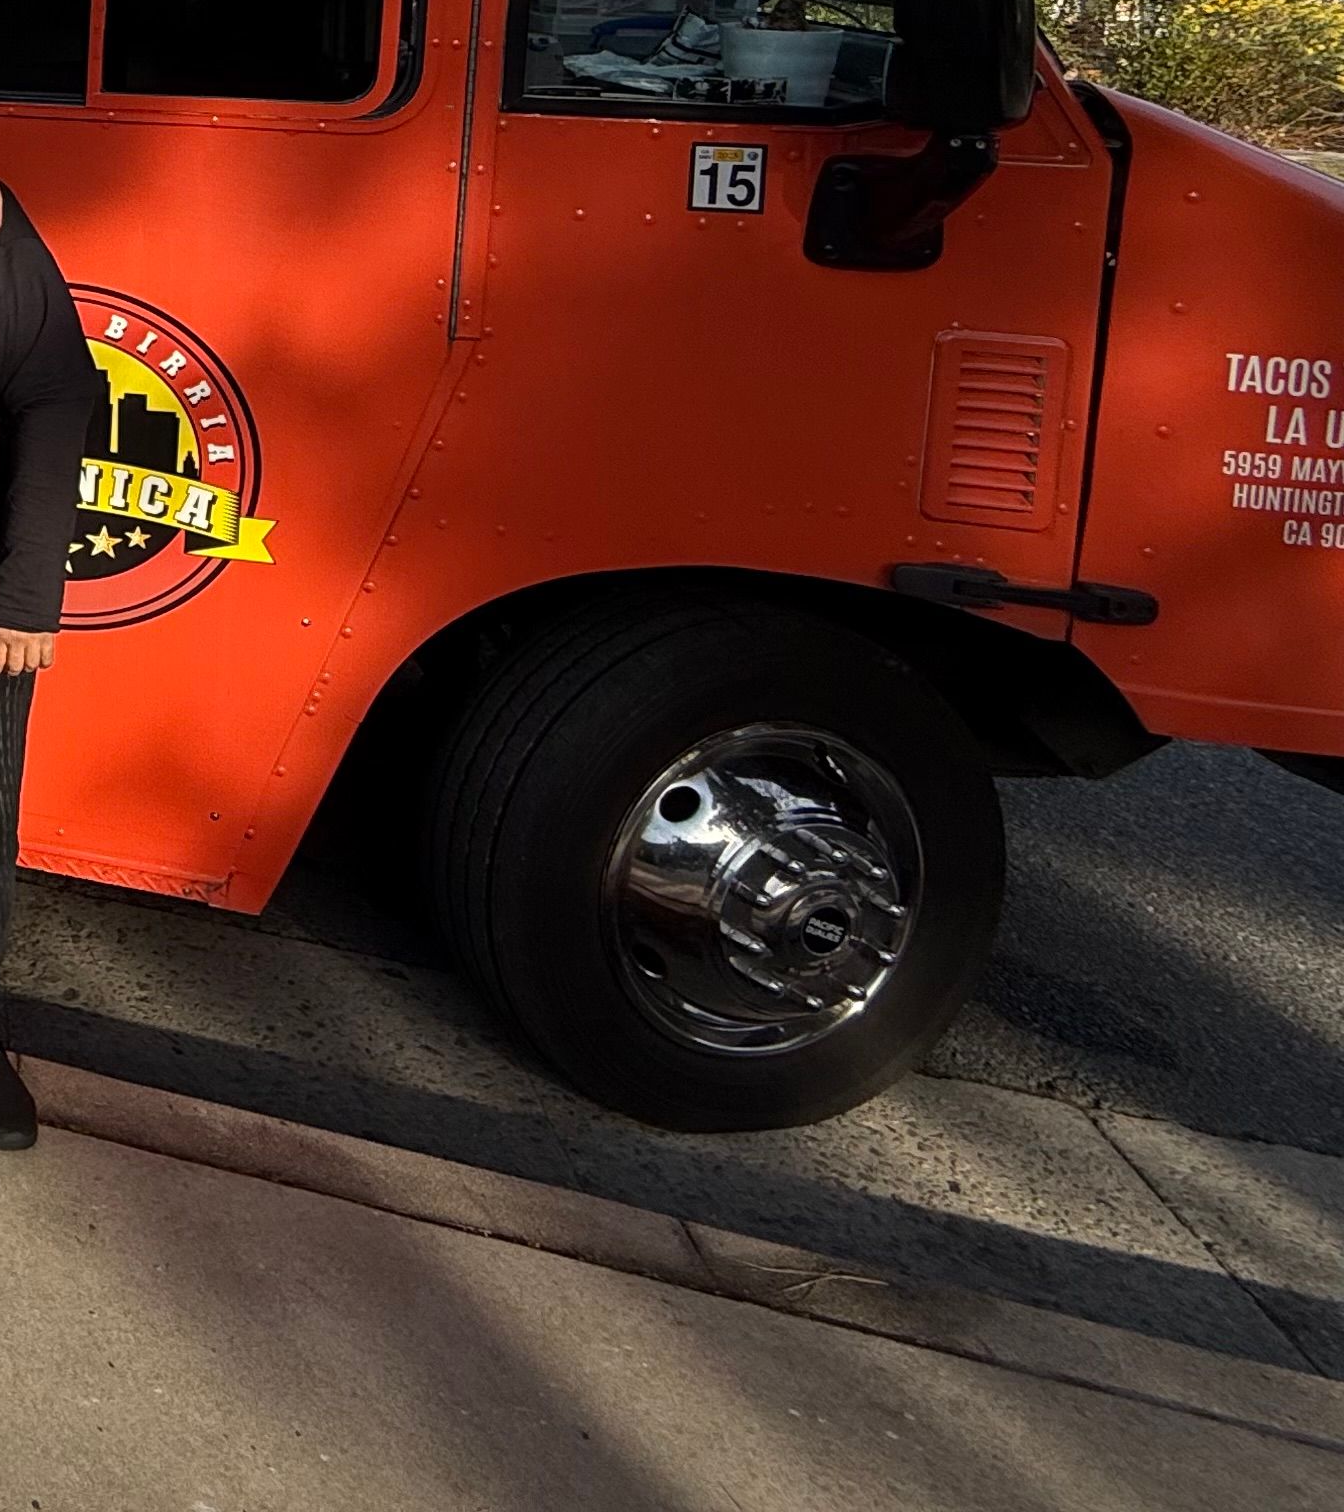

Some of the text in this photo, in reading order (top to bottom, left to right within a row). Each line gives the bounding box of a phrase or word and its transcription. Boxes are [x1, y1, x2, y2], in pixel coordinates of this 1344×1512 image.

[699, 162, 756, 207] 15
[104, 314, 235, 464] BIRRIA
[1226, 353, 1332, 399] TACOS
[1265, 405, 1307, 446] LA
[1222, 450, 1282, 479] 5959
[78, 464, 216, 531] NICA
[1283, 519, 1312, 547] CA
